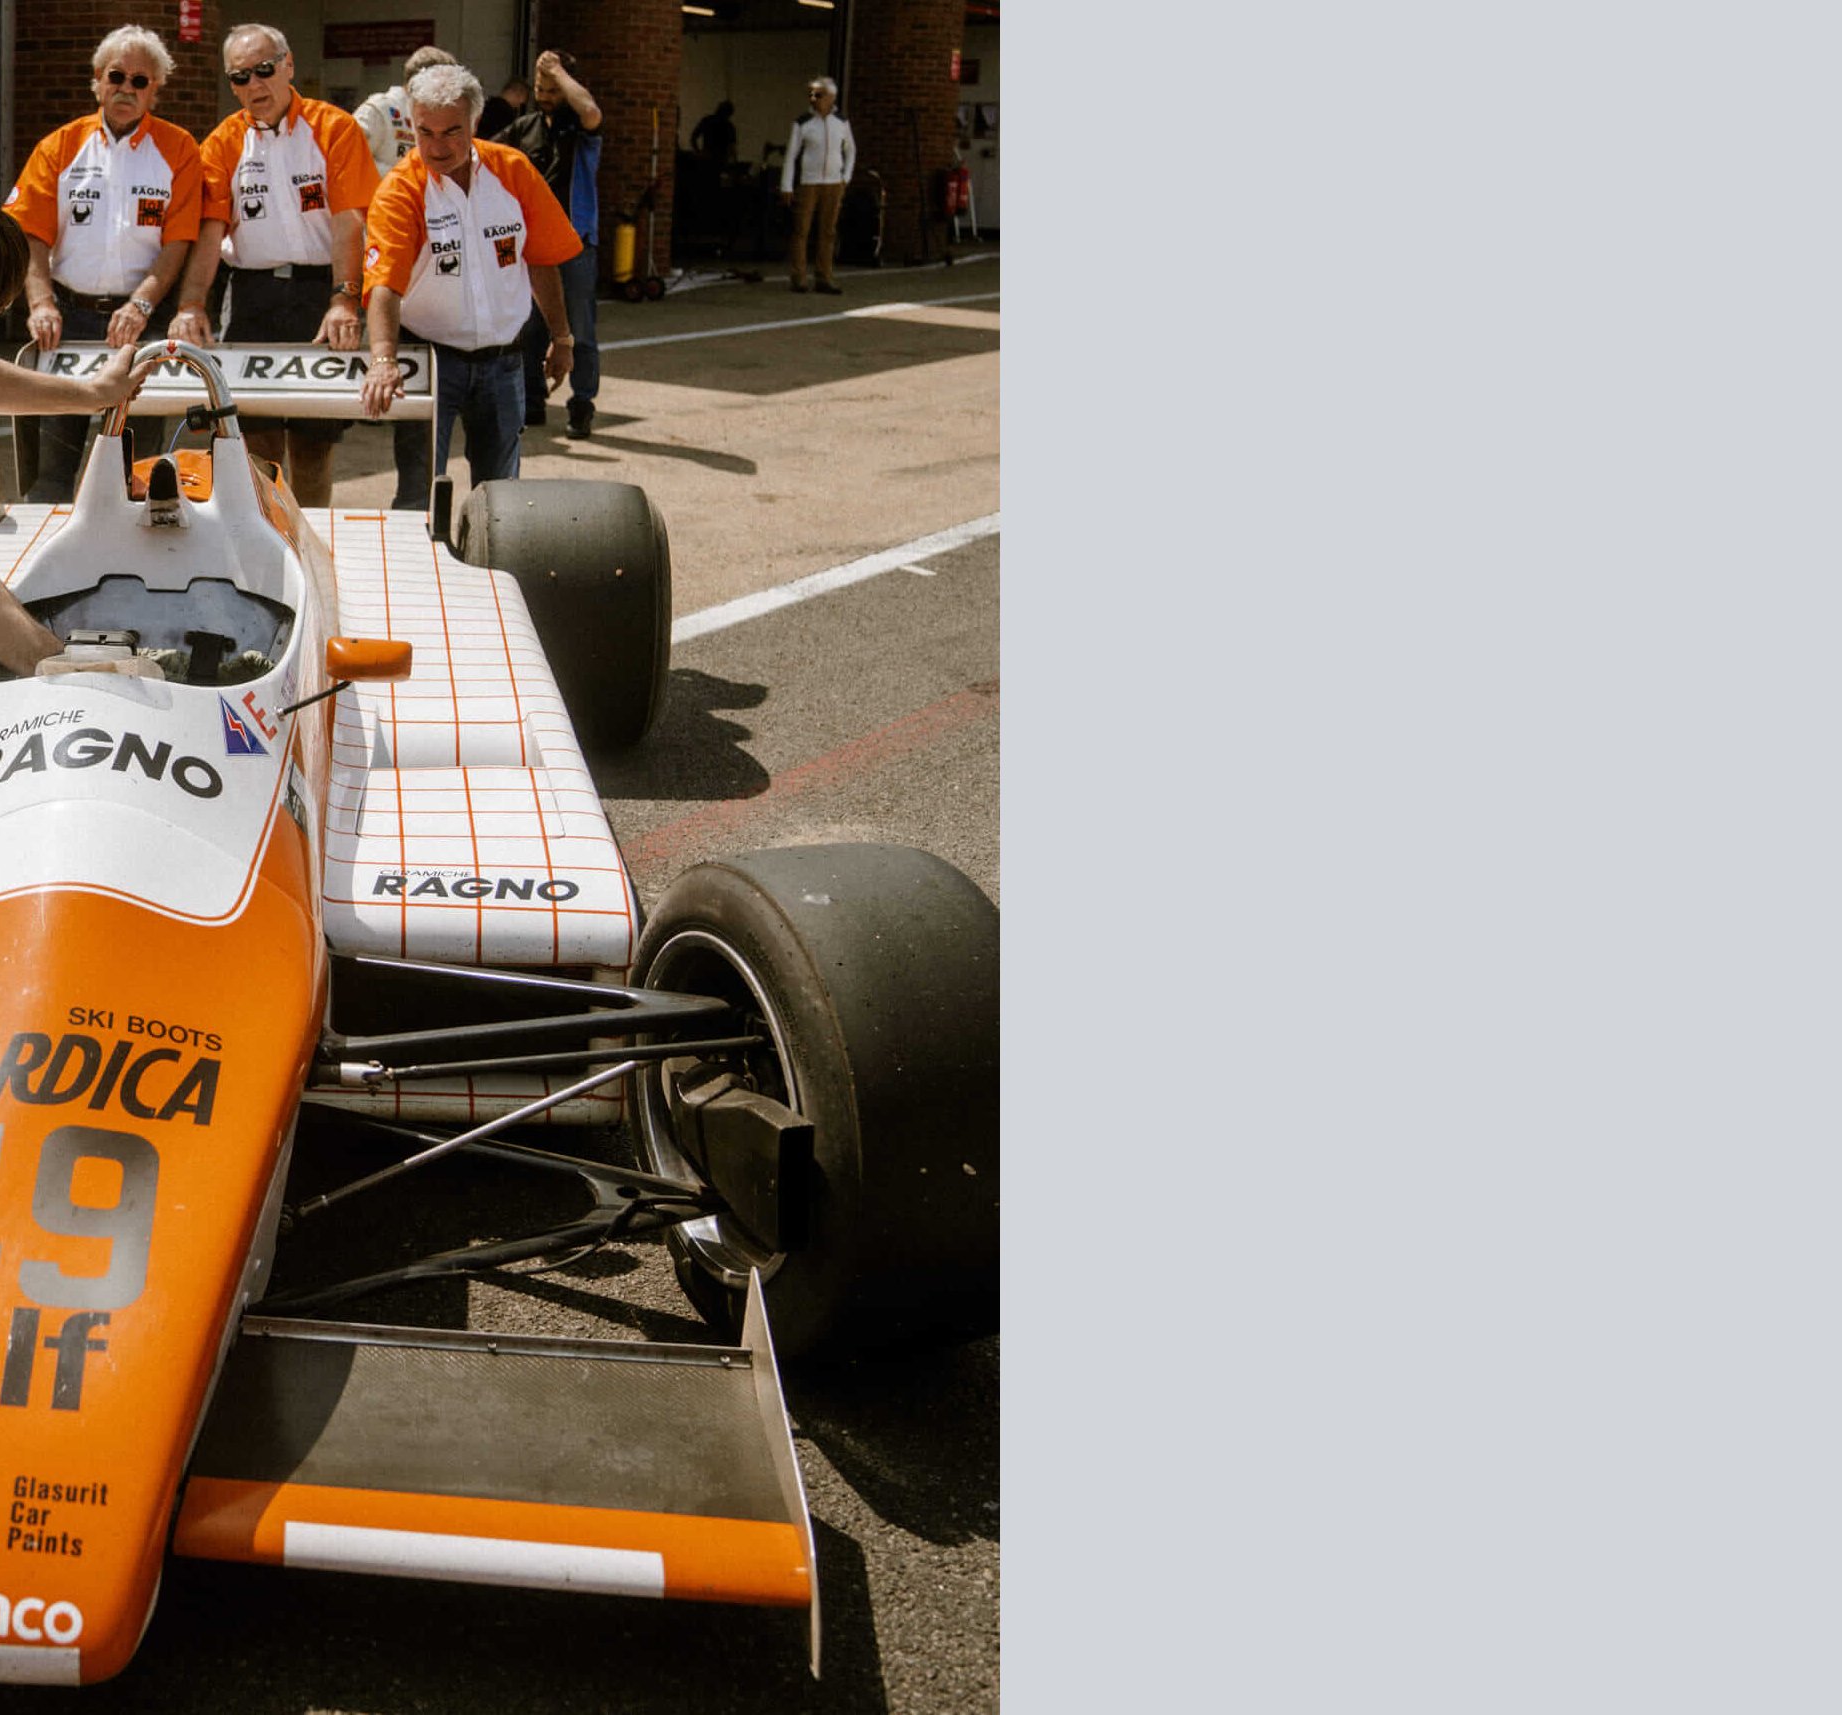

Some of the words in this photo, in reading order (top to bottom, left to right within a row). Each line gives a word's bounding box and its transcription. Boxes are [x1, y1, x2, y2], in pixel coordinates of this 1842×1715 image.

[483, 222, 522, 240] RAGNO
[379, 868, 473, 878] CERAMICHE
[371, 874, 580, 901] RAGNO
[67, 1006, 114, 1029] SKI
[127, 1015, 223, 1052] BOOTS
[14, 1476, 109, 1506] Glasurit
[10, 1501, 51, 1526] Car
[7, 1527, 84, 1557] Paints
